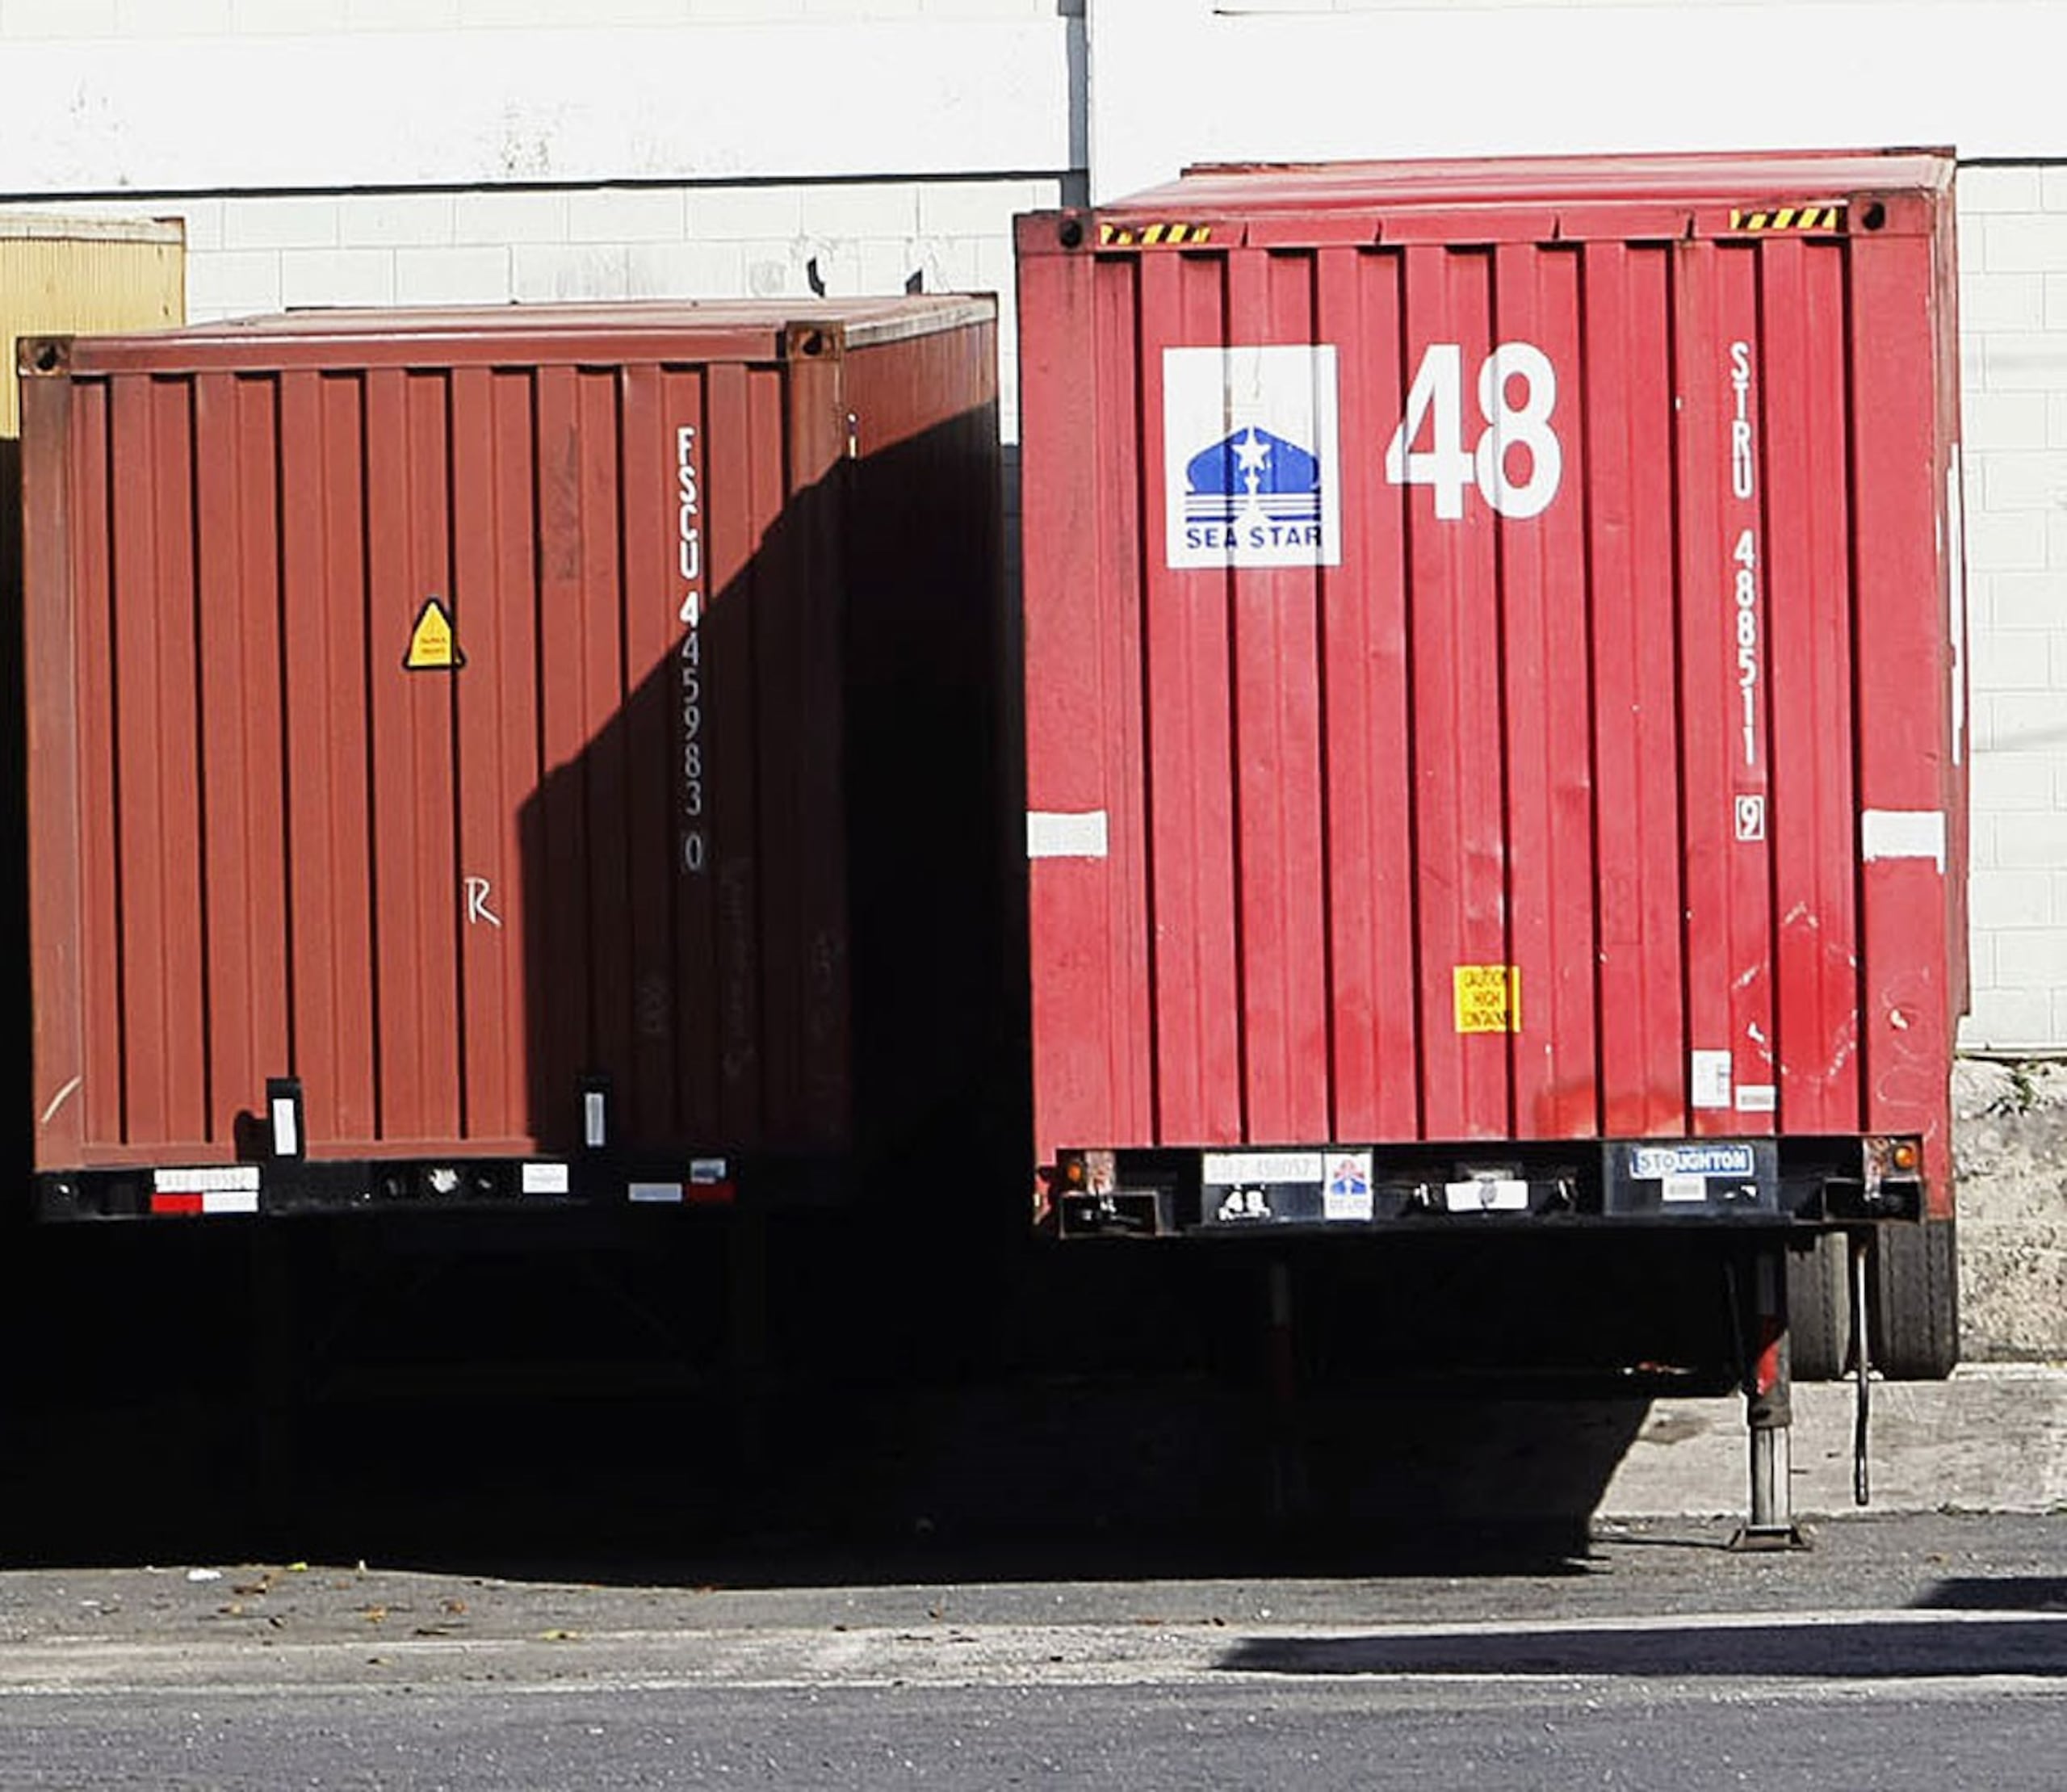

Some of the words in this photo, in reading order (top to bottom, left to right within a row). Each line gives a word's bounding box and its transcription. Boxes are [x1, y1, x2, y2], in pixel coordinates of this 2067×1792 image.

[1385, 342, 1563, 520] 48
[1729, 341, 1753, 500] STRU
[677, 426, 700, 580] FSCU
[1185, 527, 1237, 549] SEA
[1248, 526, 1322, 549] STAR
[680, 591, 702, 816] 445983
[1733, 529, 1758, 766] 488511
[464, 877, 501, 926] R
[1640, 1149, 1747, 1171] STOUGHTON
